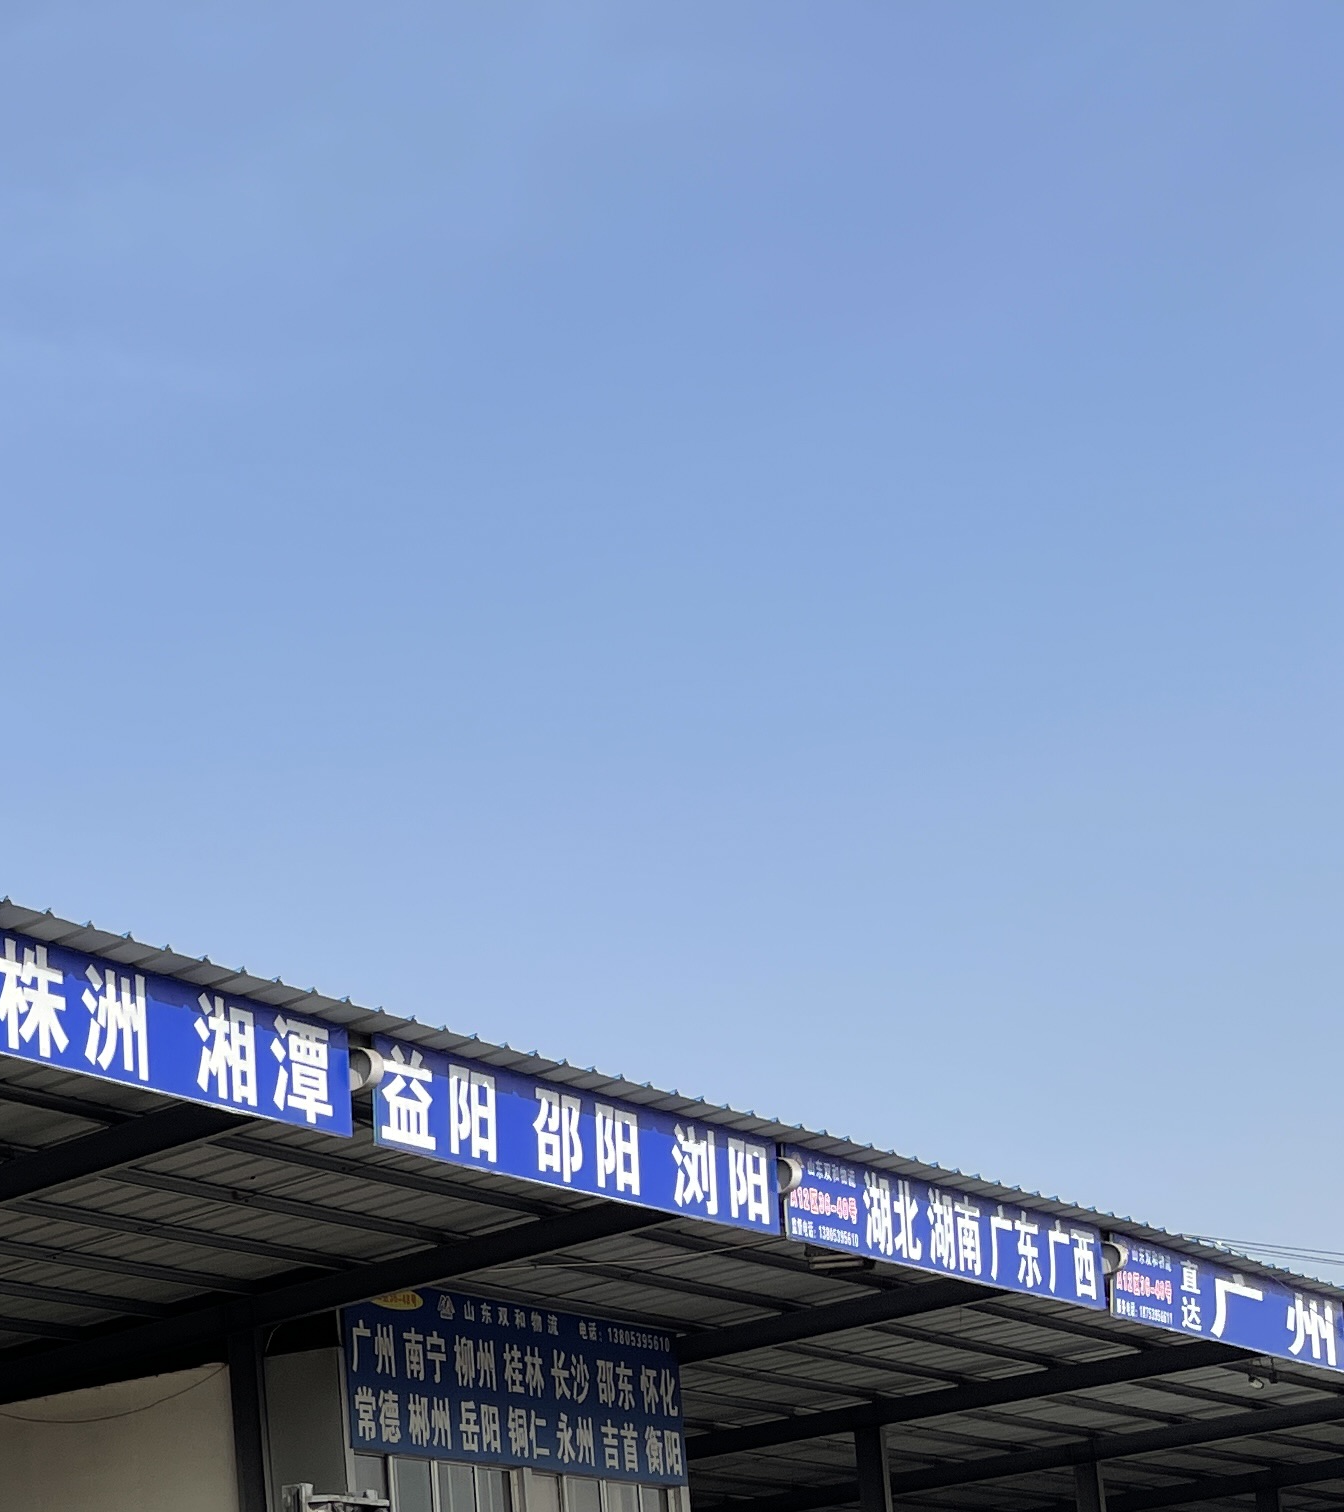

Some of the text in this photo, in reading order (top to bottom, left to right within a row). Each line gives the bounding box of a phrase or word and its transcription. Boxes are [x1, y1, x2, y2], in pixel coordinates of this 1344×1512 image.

[194, 992, 334, 1126] 湘潭
[380, 1044, 771, 1226] 益阳 邵阳 浏阳
[862, 1170, 1098, 1301] 湖北 湖南 广东 广西
[463, 1300, 560, 1337] 山东双和物流
[607, 1327, 672, 1353] 13805395610
[1179, 1259, 1203, 1332] 直达
[1210, 1273, 1337, 1367] 广州
[351, 1319, 680, 1418] 广州 南宁 柳州 桂林 长沙 邵东 怀化
[354, 1386, 684, 1478] 常德 郴州 岳阳 铜仁 永州 吉首 衡阳
